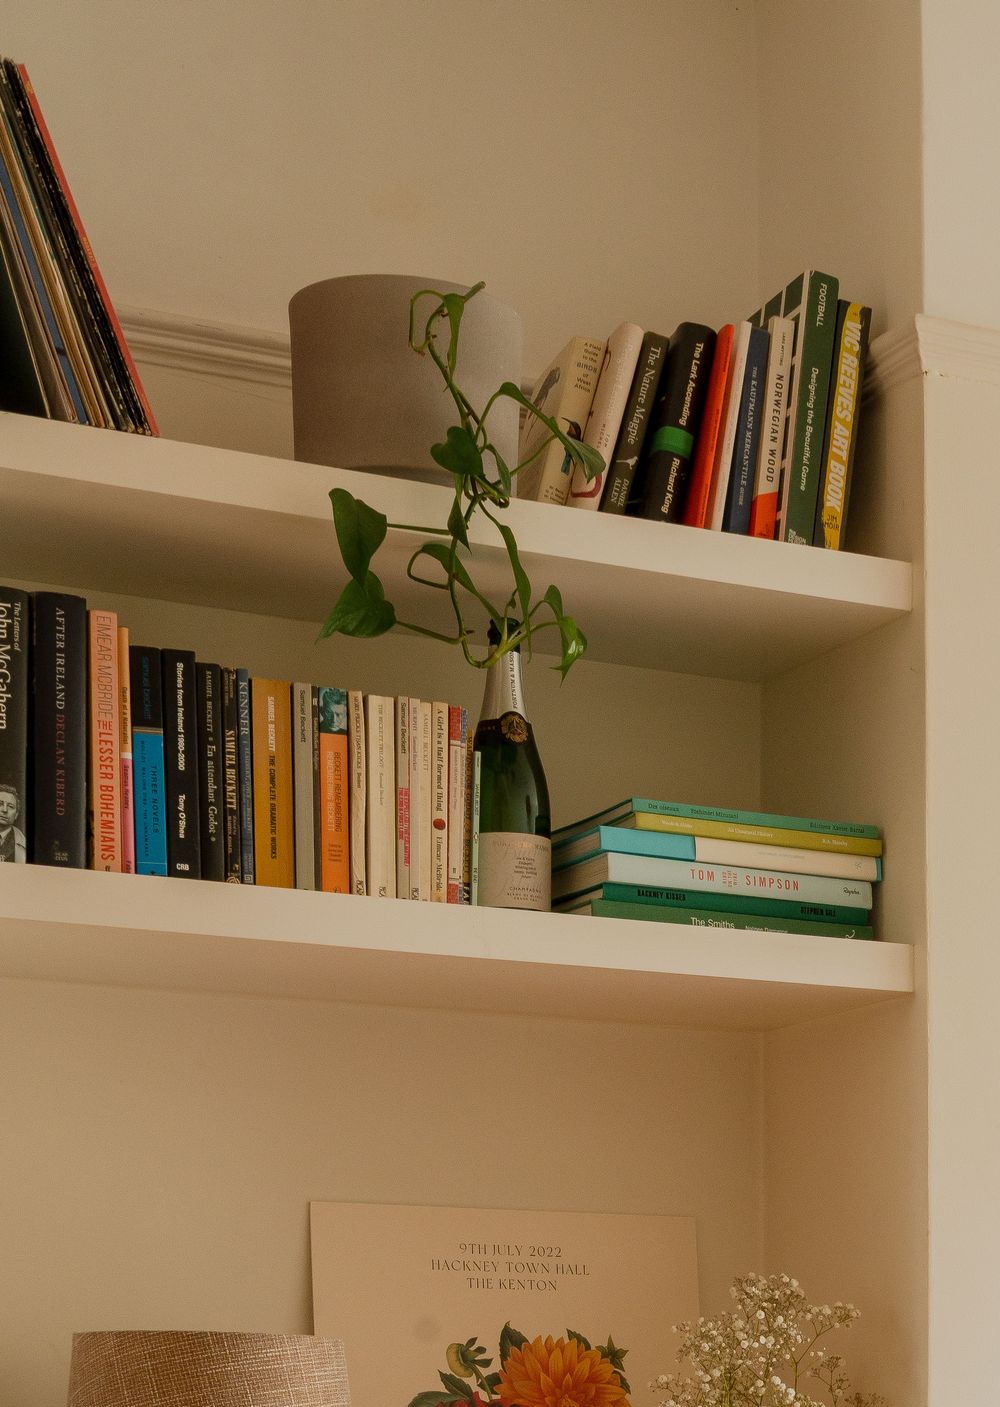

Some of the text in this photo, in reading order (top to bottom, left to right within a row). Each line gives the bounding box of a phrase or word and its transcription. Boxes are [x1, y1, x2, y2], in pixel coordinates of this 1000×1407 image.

[816, 282, 828, 327] FOOTBALL
[627, 346, 661, 445] The Nature Magpie
[679, 342, 704, 427] The Lark Ascending
[766, 373, 785, 483] NORWEGIAN WOOD
[800, 367, 819, 491] Designing the Beautiful Game
[825, 320, 861, 512] VIC REEVES ART BOOK
[740, 380, 758, 486] KAUFMANN MERCANTILE
[610, 477, 622, 504] ALLEN
[618, 478, 630, 508] DANIEL
[661, 457, 680, 514] Richard King
[14, 642, 22, 652] of
[0, 602, 13, 729] John McGahern
[96, 615, 114, 720] EIMEAR MCBRIDE
[176, 662, 185, 732] Stories from Ireland
[205, 670, 213, 698] SAMUEL
[55, 607, 65, 816] AFTER IRELAND DECLAN KIBERD
[239, 681, 250, 736] KENNER
[267, 696, 275, 722] SAMUEL
[207, 745, 216, 757] En
[268, 723, 276, 752] BECKETT
[207, 760, 217, 802] attendant
[225, 730, 237, 810] SAMUEL BECKETT
[269, 768, 277, 801] COMPLETE
[436, 764, 444, 789] formed
[98, 732, 115, 861] LESSER BOHEMIANS
[334, 752, 343, 832] BECKETT REMEMBERING
[436, 791, 444, 812] Thing
[152, 798, 160, 834] NOVELS
[177, 794, 187, 838] Tony O'Shea
[208, 806, 218, 834] Godot
[269, 803, 277, 836] DRAMATIC
[327, 801, 335, 832] BECKETT
[270, 836, 278, 860] WORKS
[176, 863, 189, 871] CRB
[435, 863, 443, 892] McBride
[690, 868, 715, 881] TOM
[637, 889, 686, 901] HACKNEY KISSES
[745, 874, 800, 892] SIMPSON
[690, 917, 735, 929] The Smiths
[800, 906, 836, 917] STEPHEN GILL
[459, 1243, 562, 1258] 9TH JULY 2022
[431, 1259, 590, 1276] HACKNEY TOWN HALL
[466, 1277, 557, 1292] THE KENTON
